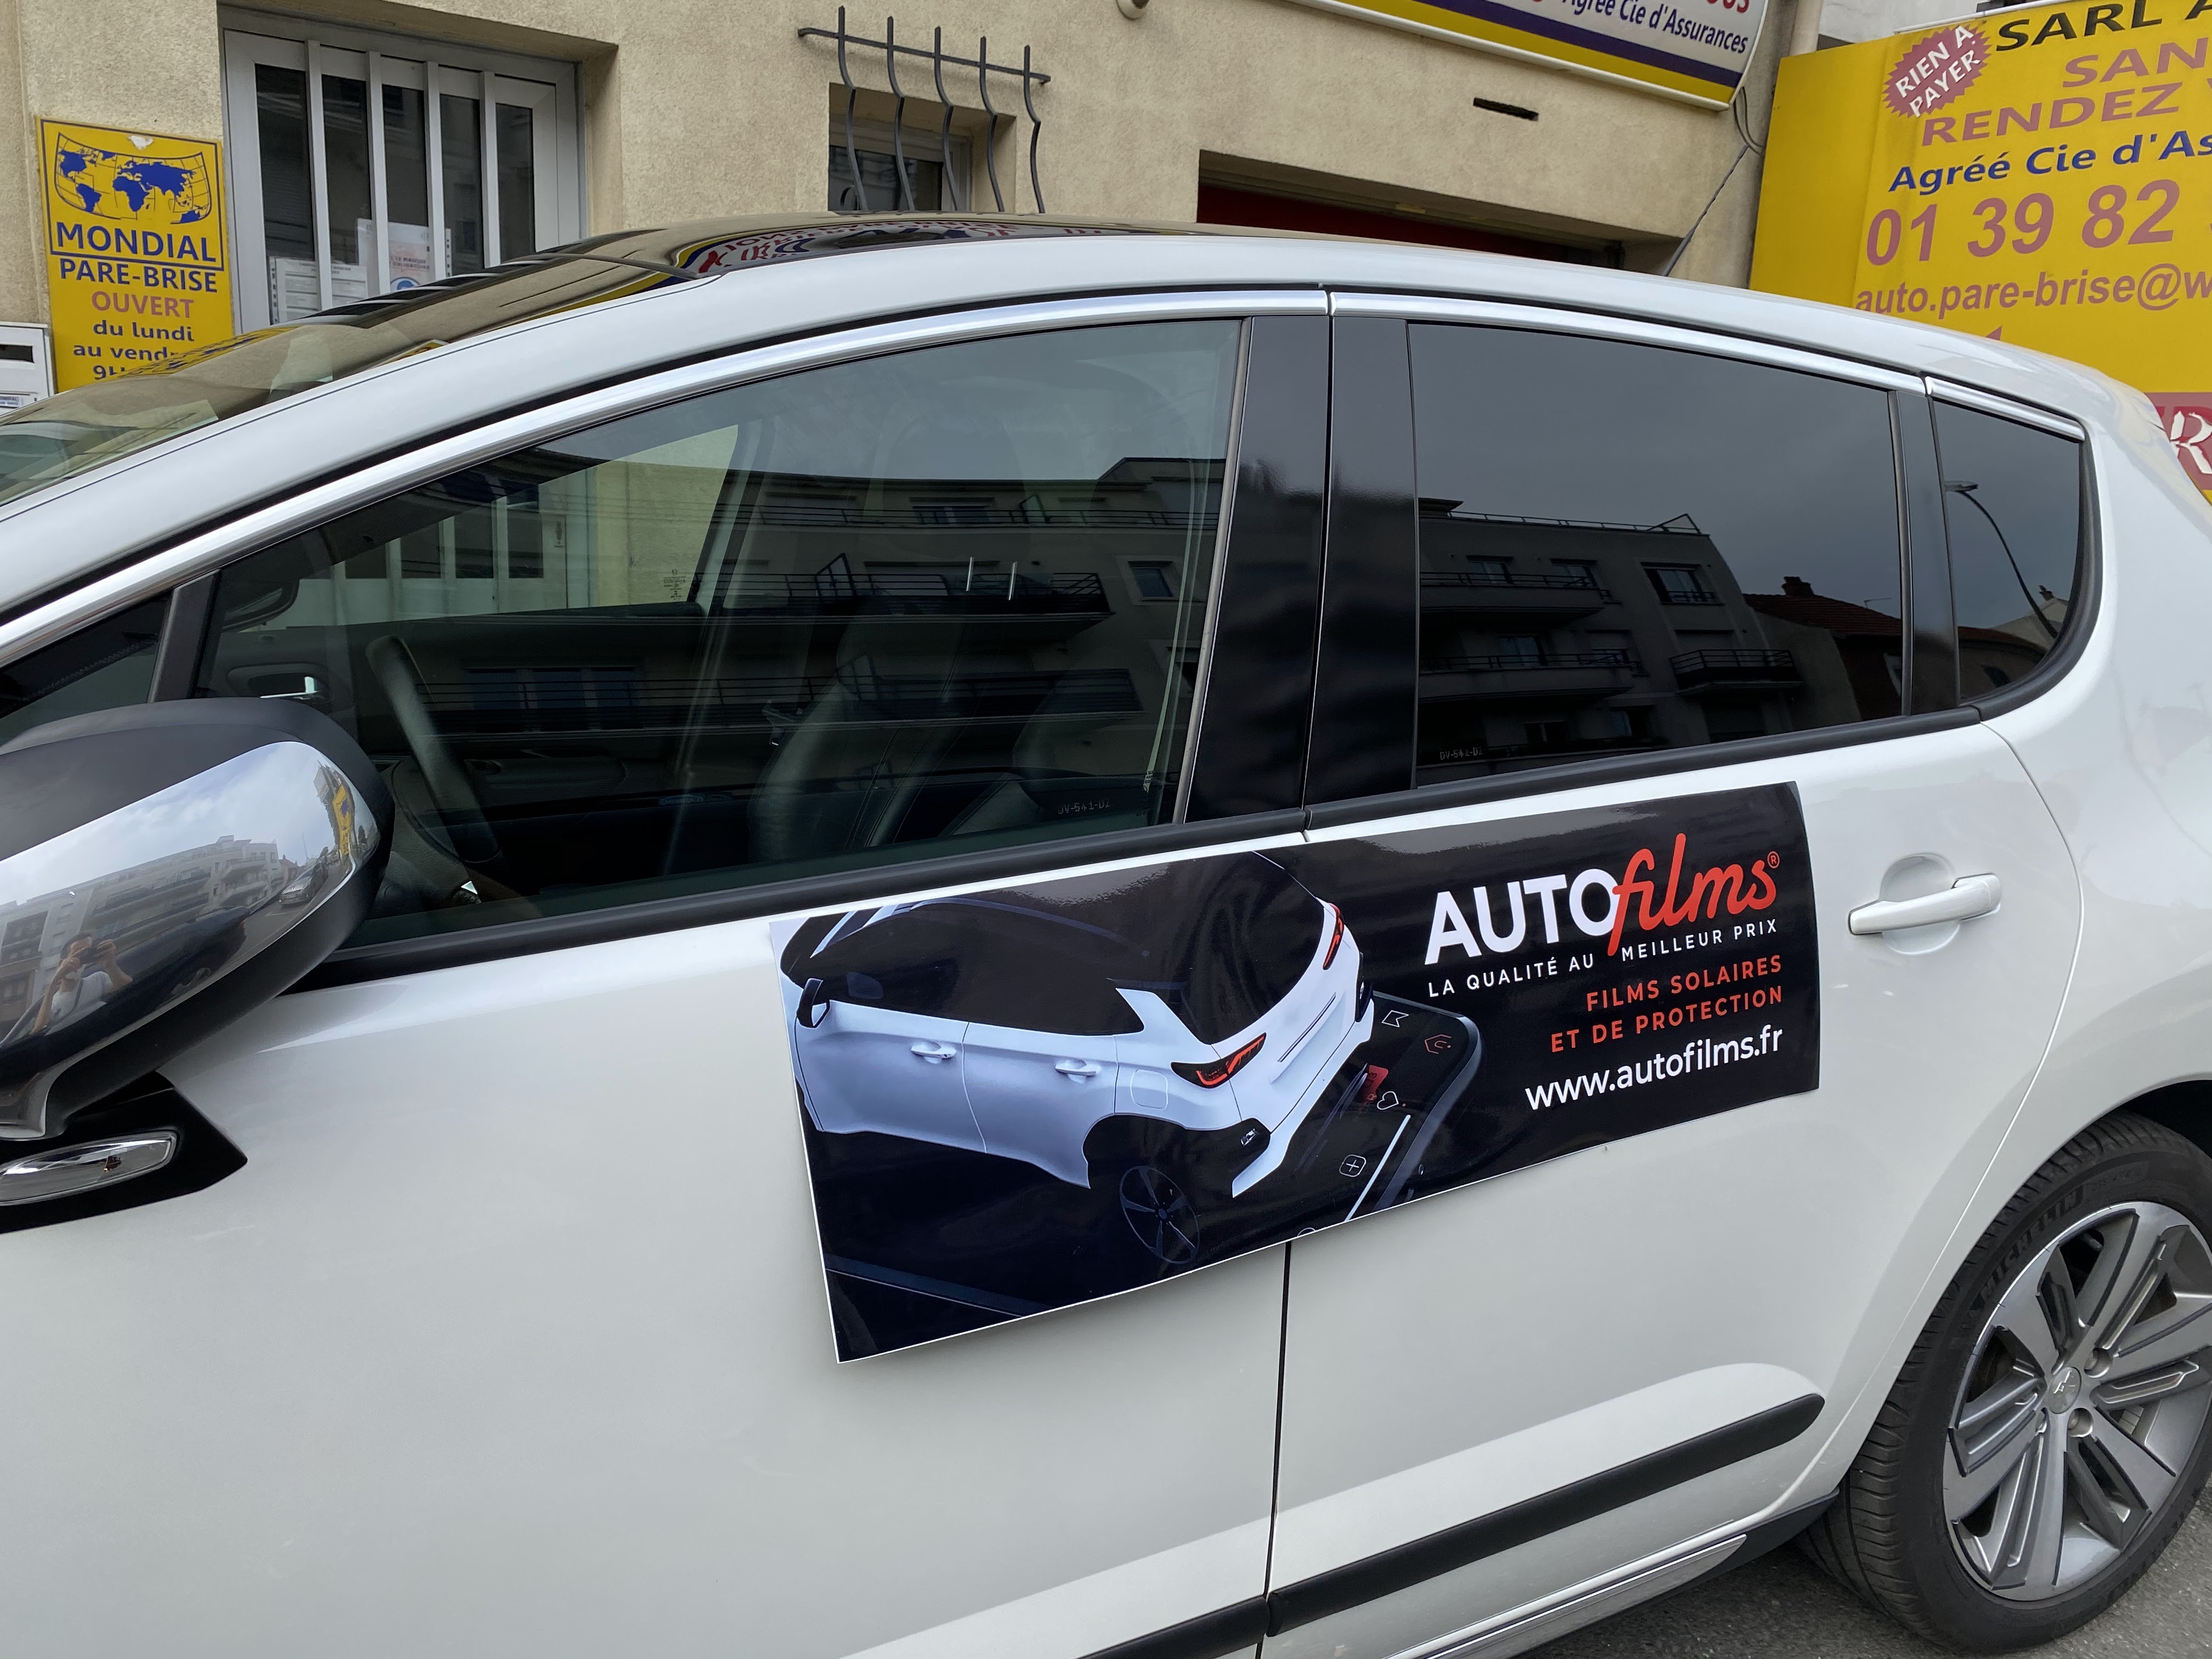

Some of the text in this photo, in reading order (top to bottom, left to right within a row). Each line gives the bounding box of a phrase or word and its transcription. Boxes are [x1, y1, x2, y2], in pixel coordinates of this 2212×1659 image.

[1620, 0, 1646, 24] Cie
[1649, 5, 1748, 53] d'Assurances
[1996, 0, 2162, 51] SARL
[1896, 42, 1950, 97] RIEN
[1910, 50, 1980, 116] PAYER
[2063, 38, 2208, 87] SAN
[1921, 82, 2182, 145] RENDEZ
[1889, 131, 2212, 196] Agréé Cie d'As
[56, 222, 216, 262] MONDIAL
[1867, 179, 2179, 265] 01 39 82
[60, 258, 217, 293] PARE-BRISE
[1856, 263, 2212, 319] auto.pare-brise@w
[92, 291, 193, 317] OUVERT
[93, 320, 194, 341] du lundi
[73, 345, 178, 360] au vend
[1429, 919, 1776, 997] LA QUALITÉ AU MEILLEUR PRIX
[1587, 955, 1781, 1011] FILMS SOLAIRES
[1551, 986, 1781, 1052] ET DE PROTECTION
[1525, 1025, 1782, 1110] www.autofilms.fr
